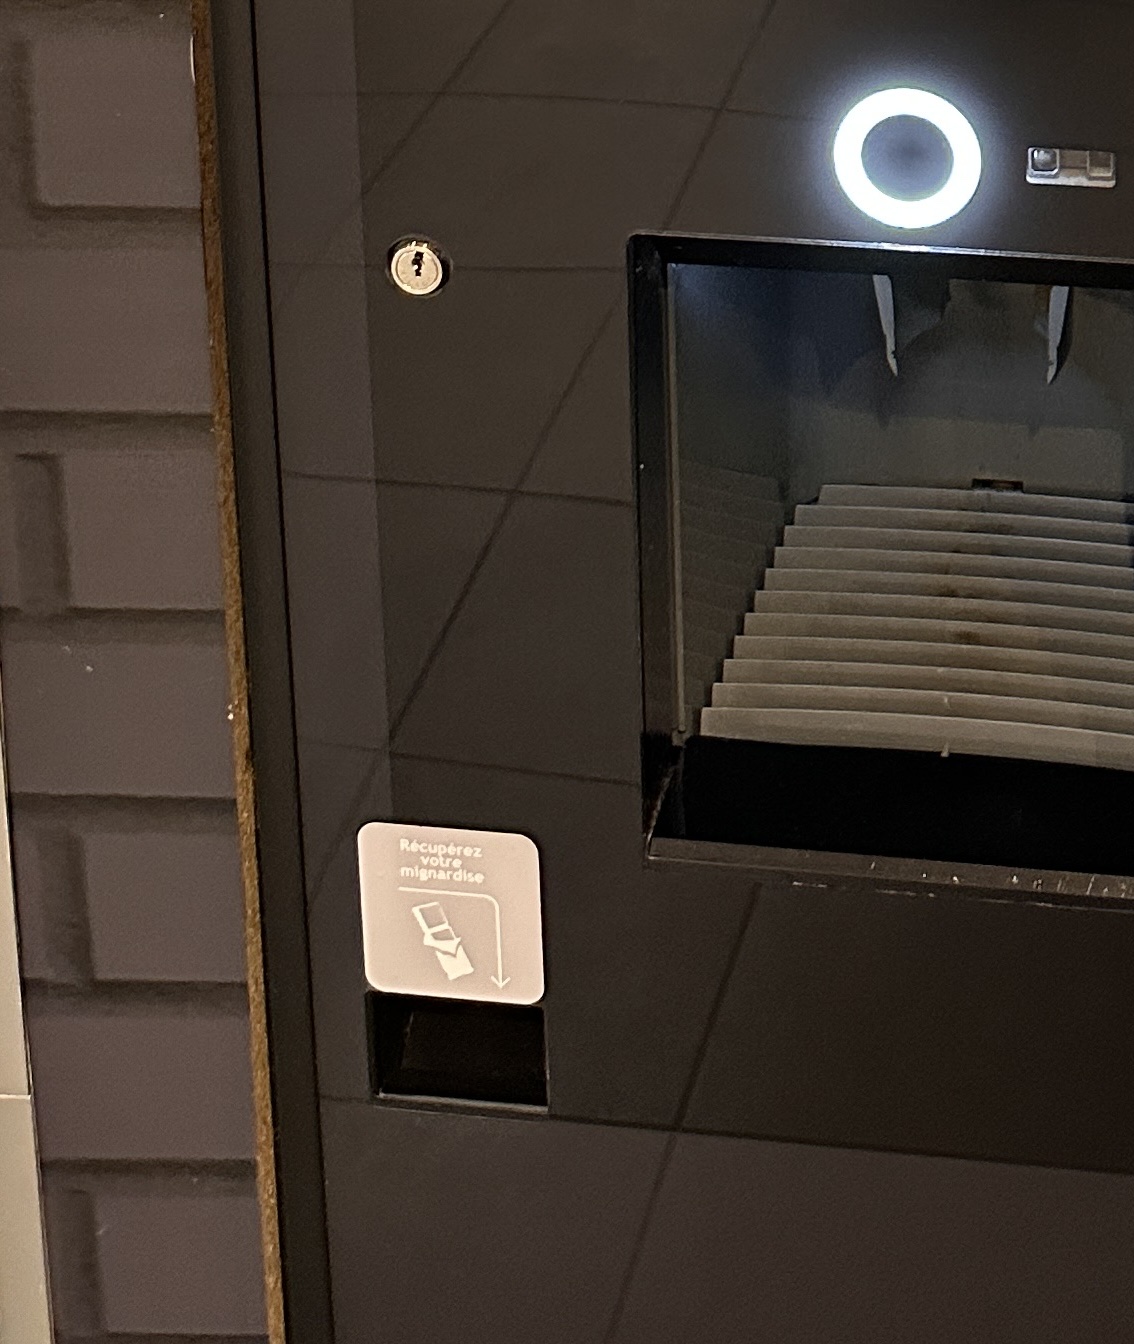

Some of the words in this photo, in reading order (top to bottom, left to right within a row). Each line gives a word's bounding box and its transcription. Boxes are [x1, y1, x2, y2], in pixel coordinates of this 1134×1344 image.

[400, 838, 483, 858] Récupérez
[420, 855, 463, 868] votre
[400, 865, 485, 885] mignardise
